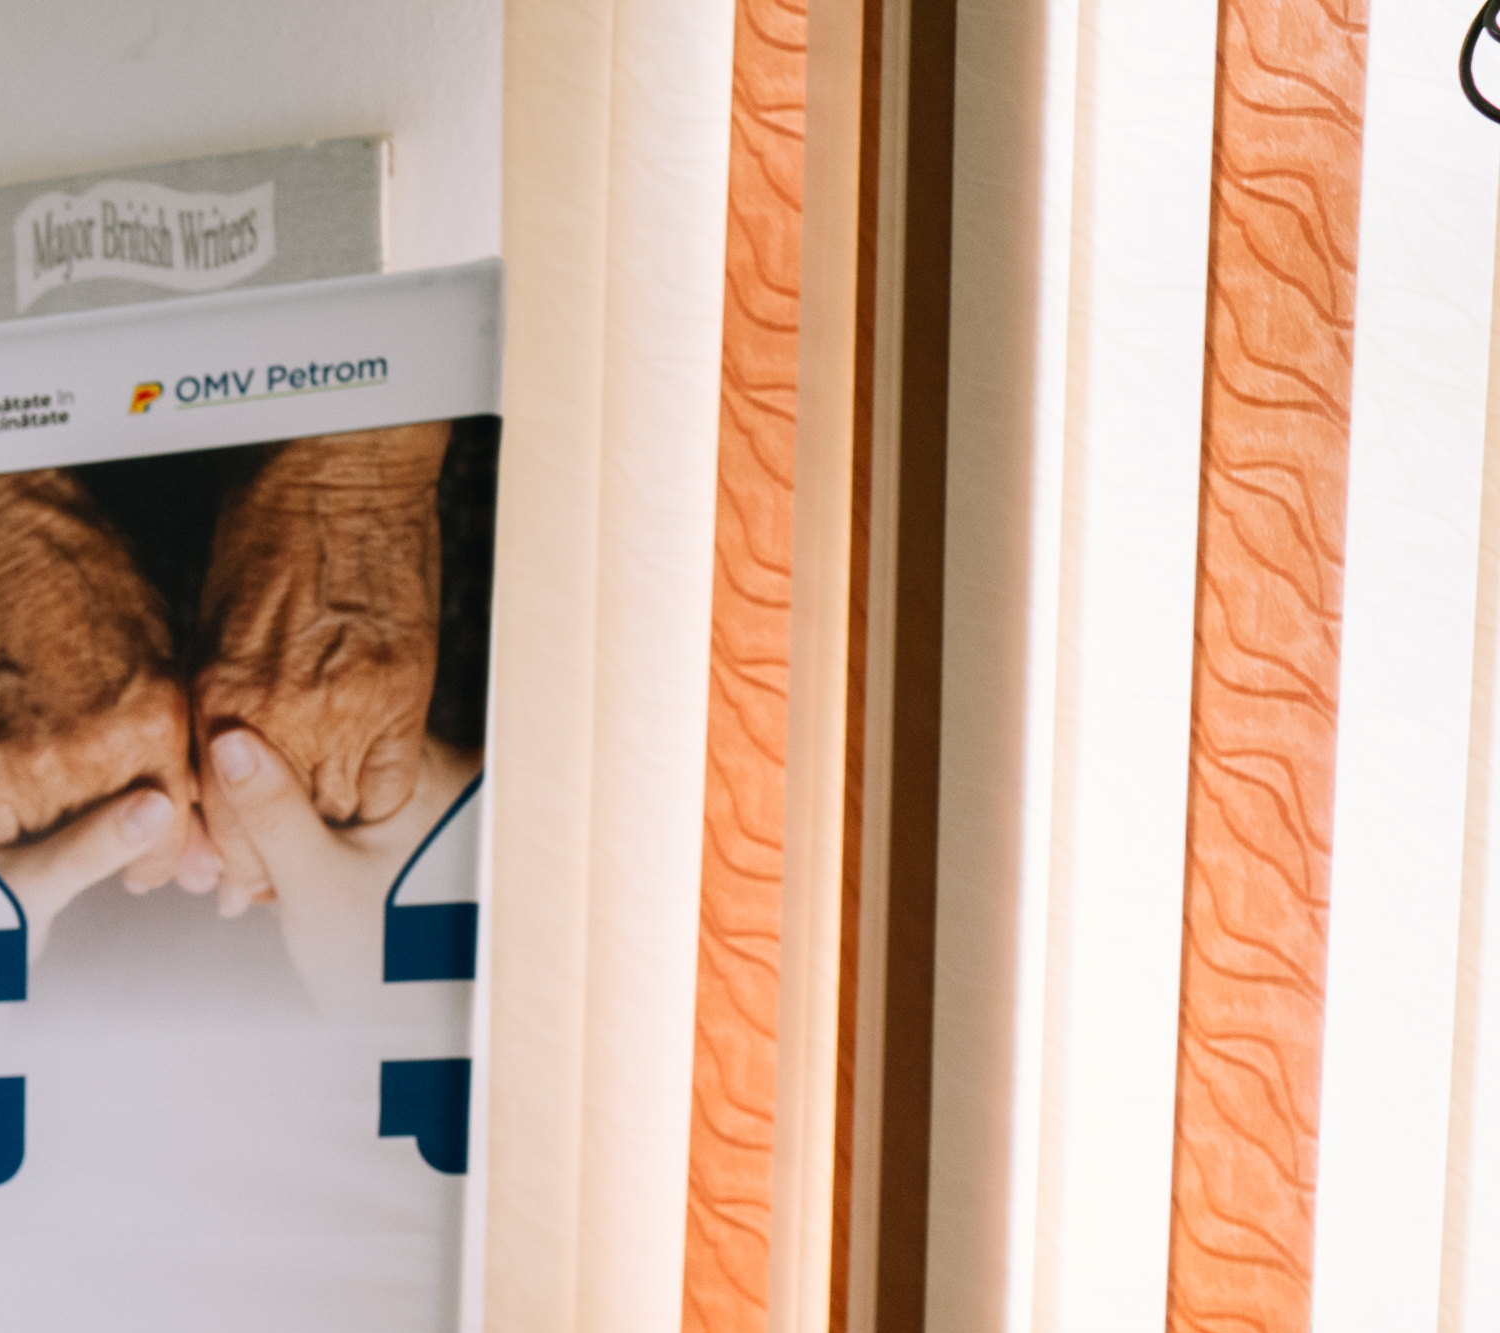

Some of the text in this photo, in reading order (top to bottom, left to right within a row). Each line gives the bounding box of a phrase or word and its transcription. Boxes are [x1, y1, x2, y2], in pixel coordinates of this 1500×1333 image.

[32, 200, 259, 281] Major British Writers
[175, 357, 388, 403] OMV Petrom
